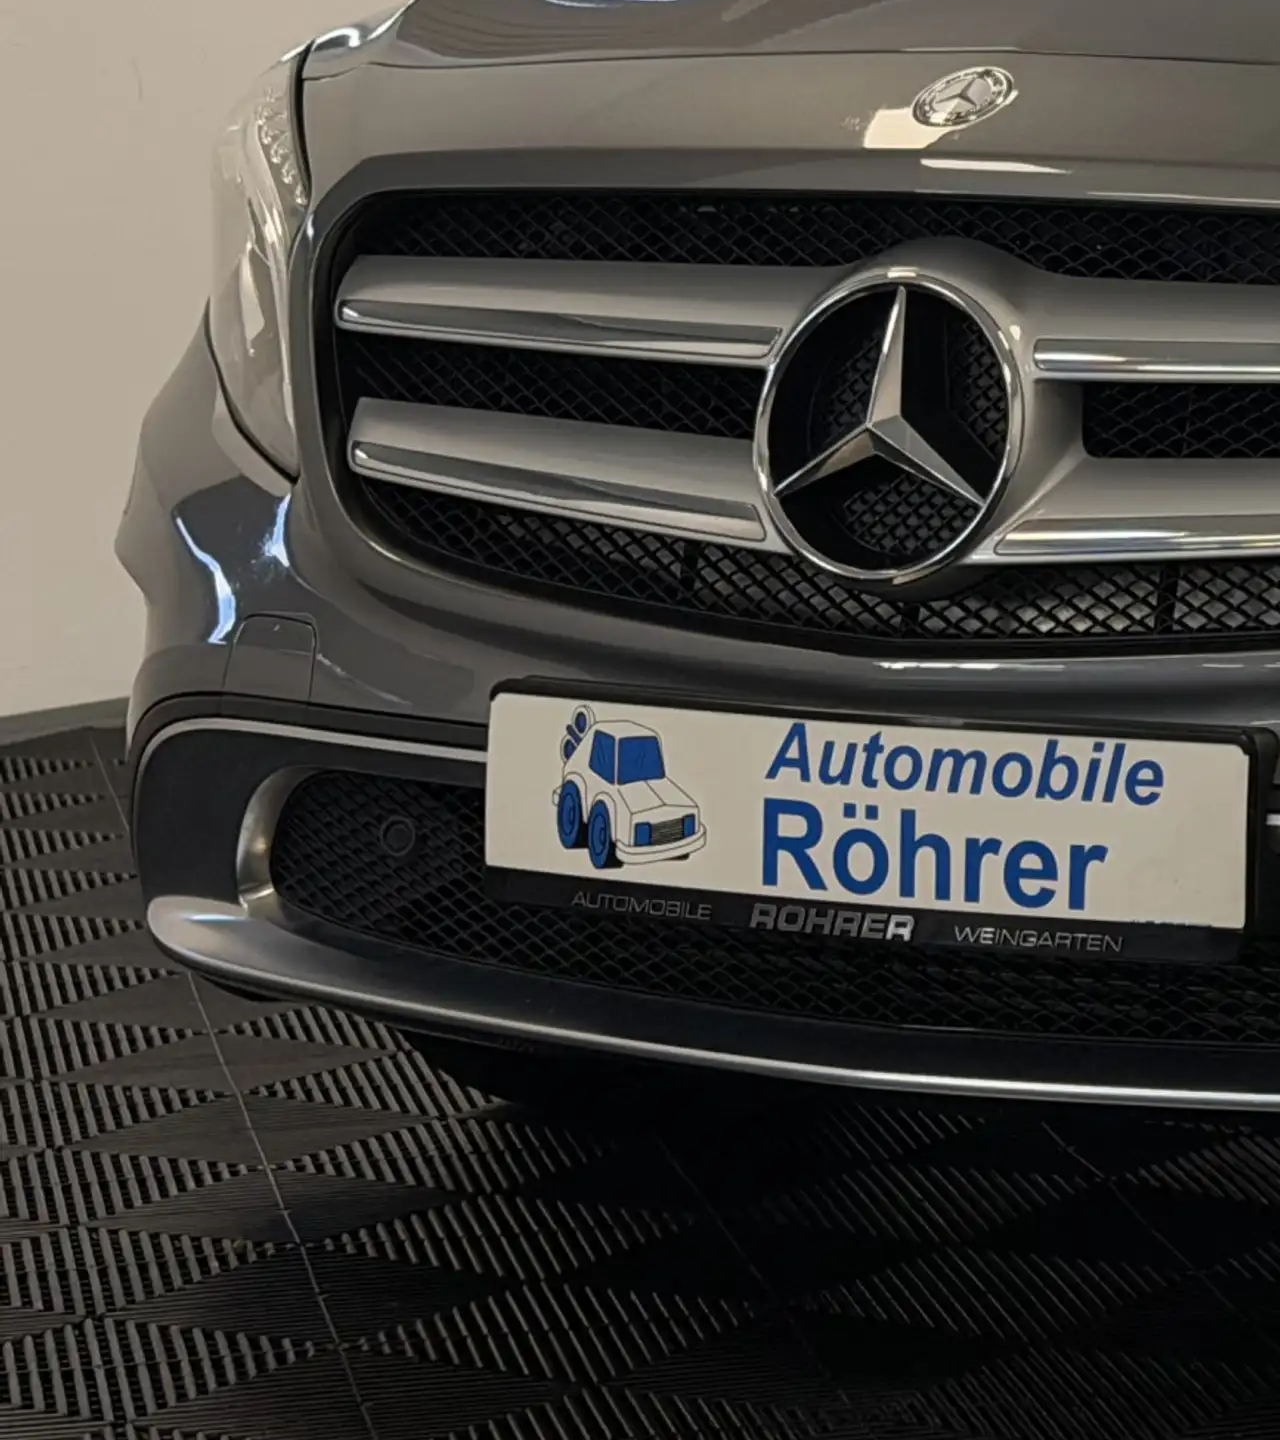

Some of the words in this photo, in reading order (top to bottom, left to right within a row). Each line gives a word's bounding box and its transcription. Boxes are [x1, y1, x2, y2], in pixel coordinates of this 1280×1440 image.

[764, 722, 1164, 806] Automobile
[763, 797, 1109, 911] Röhrer
[571, 891, 713, 921] AUTOMOBILE
[953, 925, 1124, 953] WEINGARTEN
